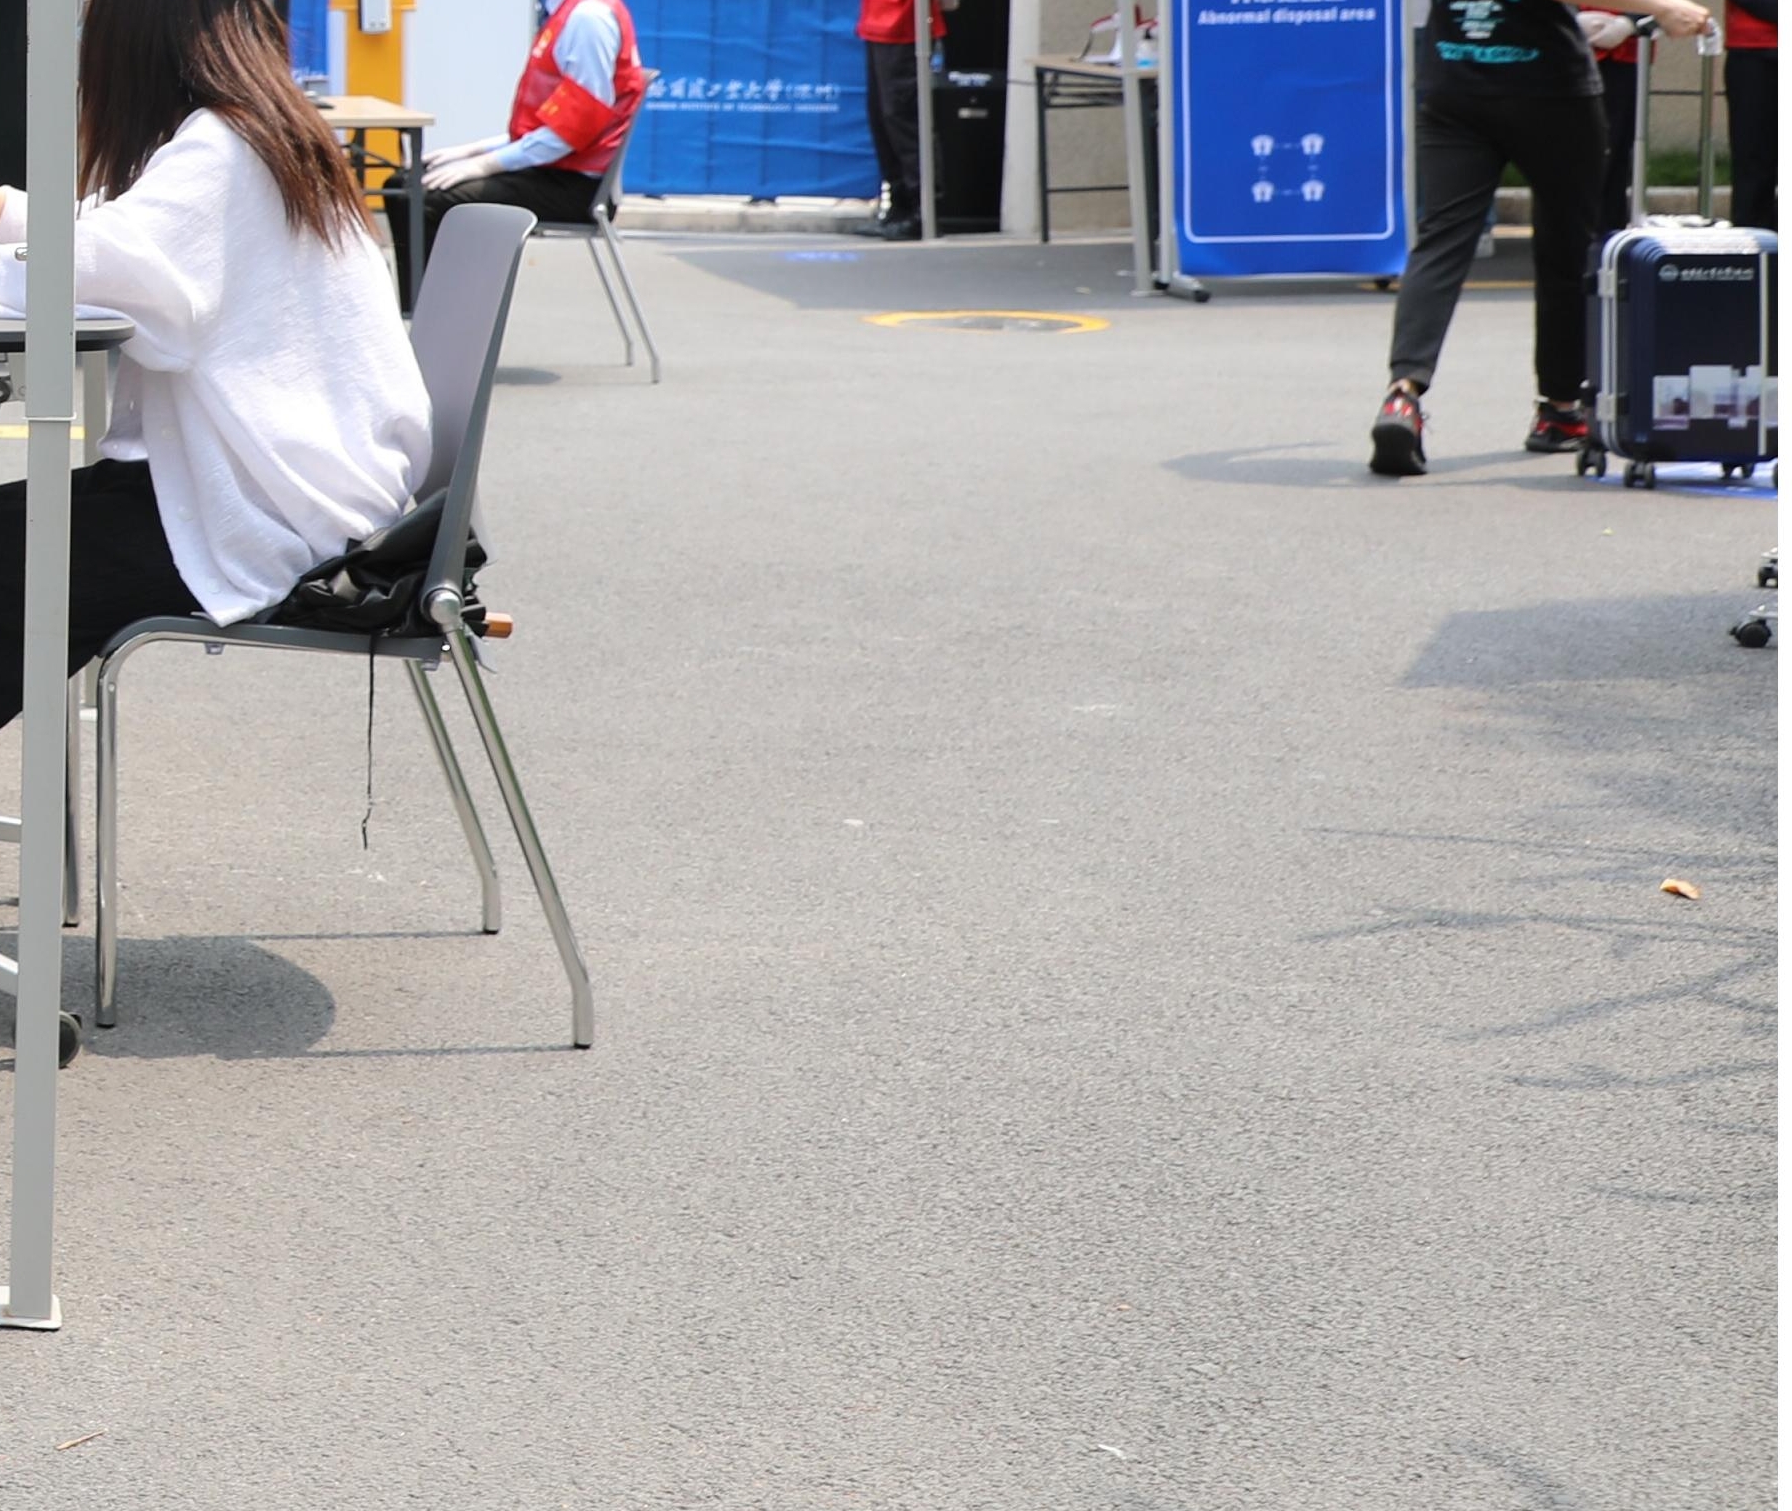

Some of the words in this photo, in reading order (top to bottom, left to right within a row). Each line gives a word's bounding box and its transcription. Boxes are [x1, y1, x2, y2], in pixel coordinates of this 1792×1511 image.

[1198, 9, 1271, 25] Abnormal
[1272, 7, 1338, 26] disposal
[1340, 8, 1376, 21] area
